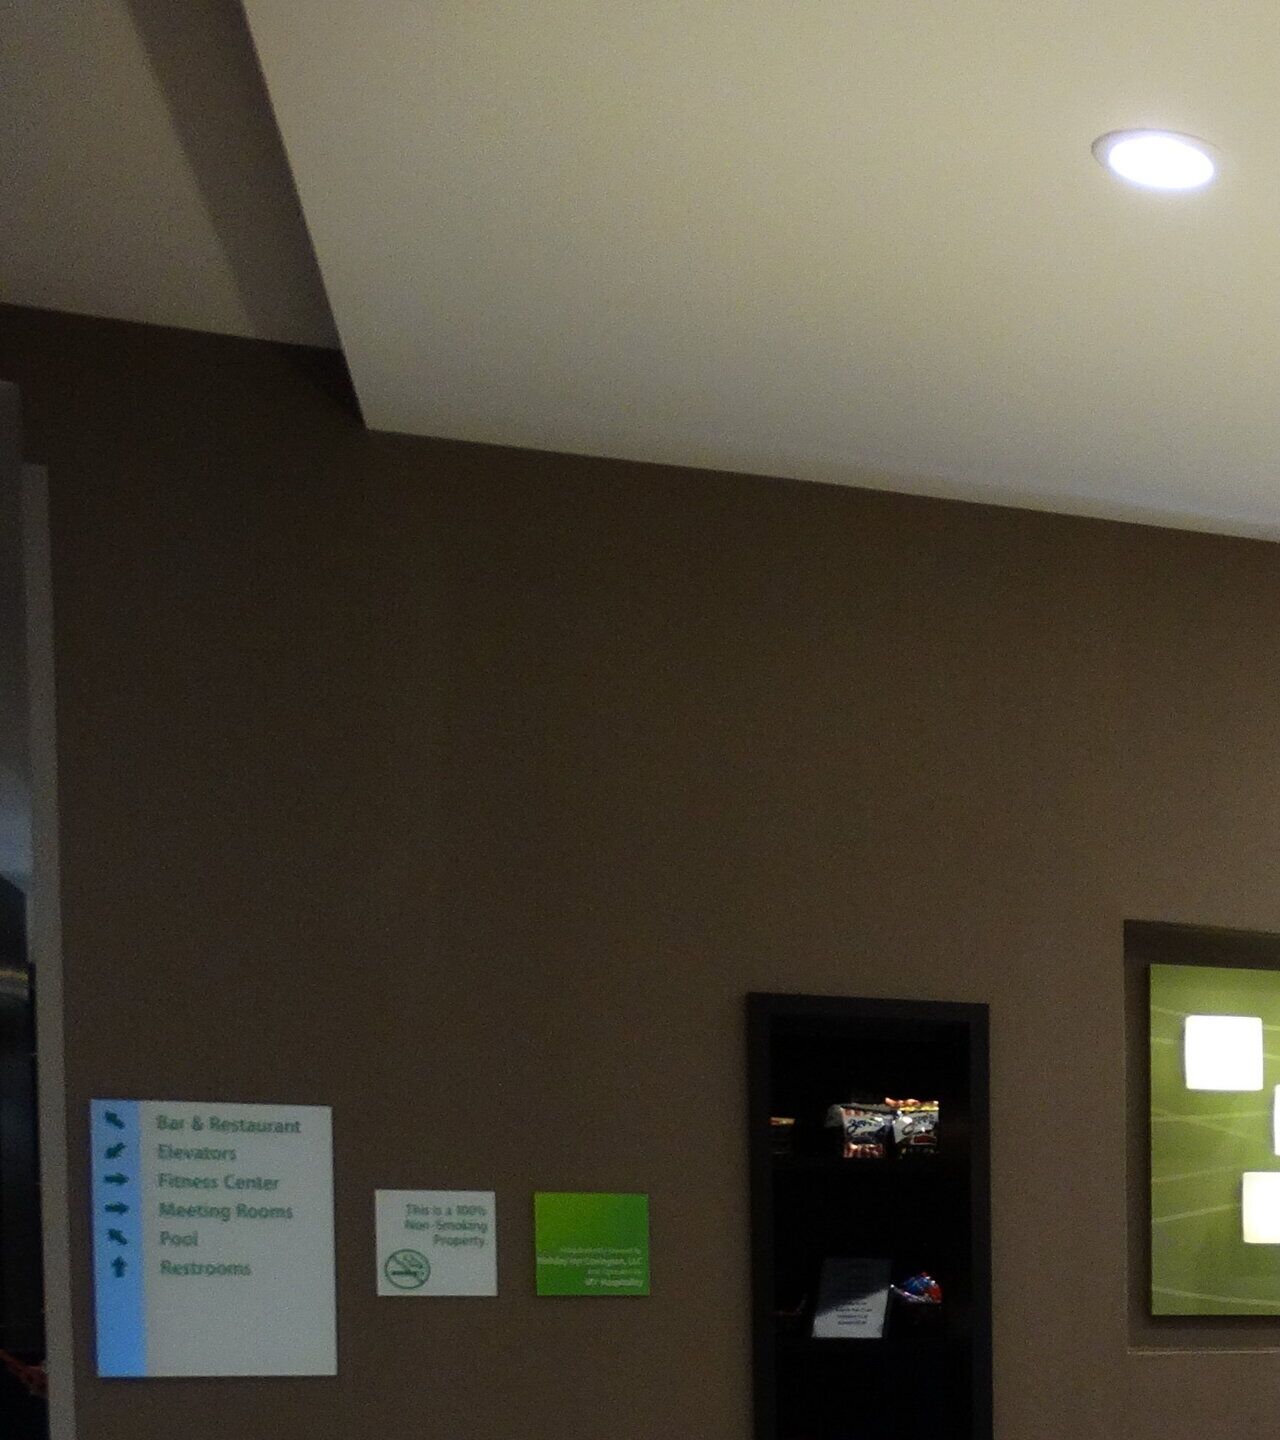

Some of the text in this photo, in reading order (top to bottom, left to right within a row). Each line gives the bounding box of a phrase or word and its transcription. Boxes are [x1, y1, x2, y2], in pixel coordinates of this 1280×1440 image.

[157, 1115, 301, 1133] Bar & Restaurant
[158, 1144, 237, 1161] Elevators
[158, 1172, 280, 1191] Fitness Center
[159, 1202, 293, 1223] Meeting Rooms
[405, 1203, 430, 1216] This
[432, 1204, 442, 1216] is
[160, 1231, 198, 1247] Pool
[433, 1234, 485, 1248] Property
[160, 1259, 251, 1277] Restrooms
